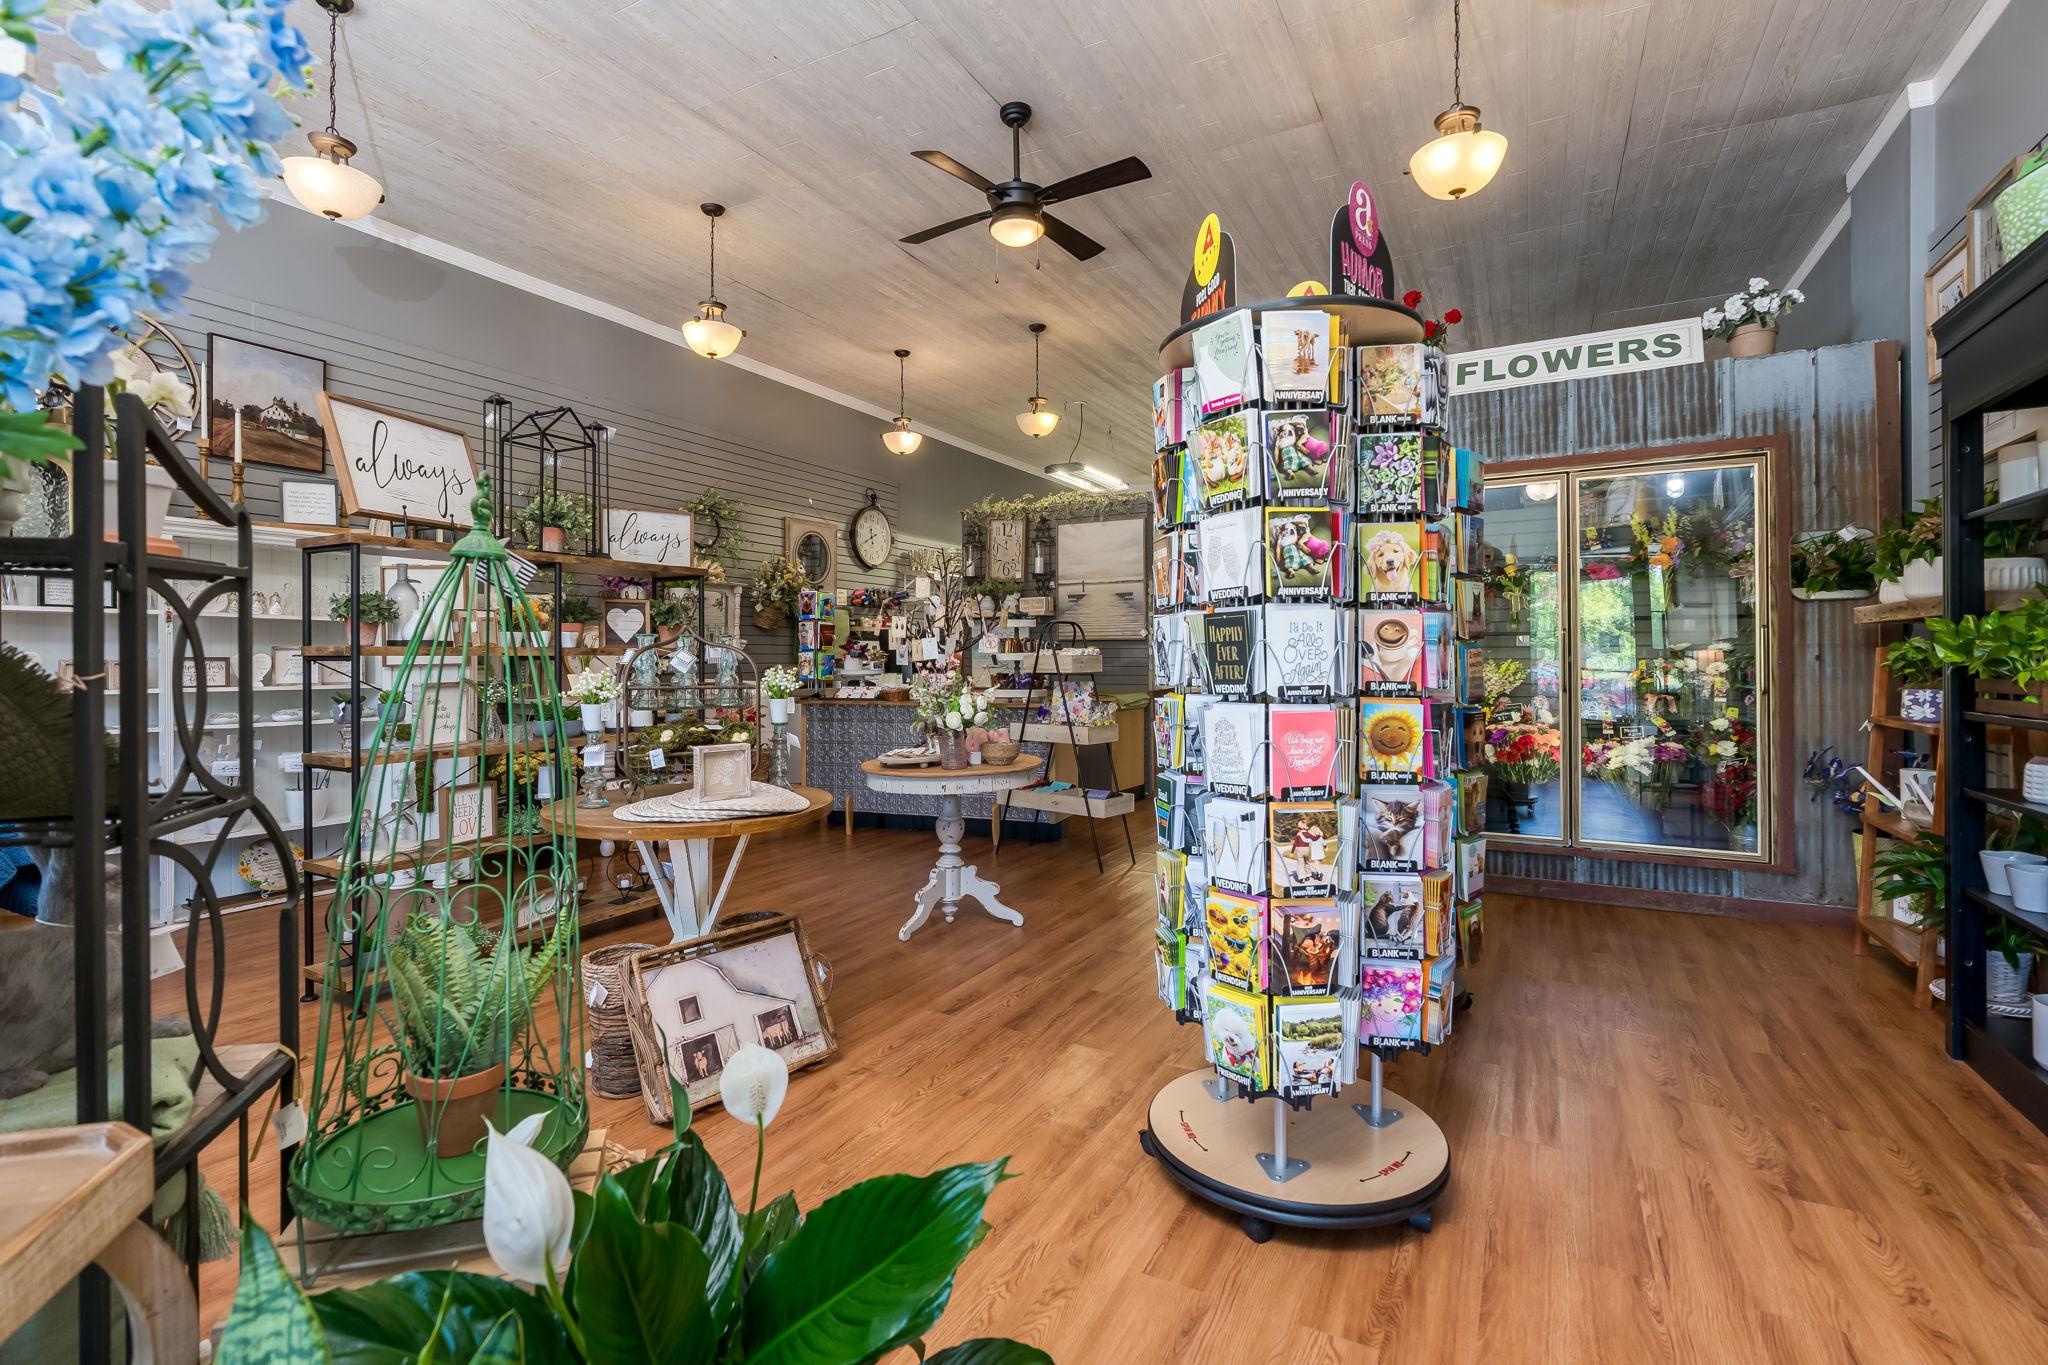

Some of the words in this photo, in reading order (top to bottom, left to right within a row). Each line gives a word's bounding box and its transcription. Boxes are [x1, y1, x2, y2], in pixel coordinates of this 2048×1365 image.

[1341, 240, 1385, 299] HUMOR
[1207, 272, 1220, 296] GOOD
[1456, 333, 1682, 386] FLOWERS
[1275, 390, 1325, 400] ANNIVERSARY
[1370, 414, 1397, 424] BLANK
[356, 420, 471, 518] always
[1210, 489, 1242, 505] WEDDING
[1278, 488, 1328, 498] ANNIVERSARY
[1370, 504, 1398, 512] BLANK
[1002, 522, 1013, 537] 12
[608, 512, 689, 562] always
[1002, 561, 1010, 576] 6
[1211, 588, 1243, 600] WEDDING
[1278, 586, 1328, 596] ANNIVERSARY
[1302, 622, 1314, 632] Do
[1316, 621, 1324, 632] It
[1208, 625, 1244, 642] HAPPILY
[1216, 644, 1239, 662] EVER
[1214, 663, 1244, 680] AFTER!
[1283, 661, 1328, 684] Again
[1215, 684, 1247, 694] WEDDING
[1370, 682, 1397, 690] BLANK
[1370, 772, 1398, 780] BLANK
[1215, 784, 1247, 795] WEDDING
[452, 806, 474, 818] NEED
[452, 816, 486, 838] LOVE
[1370, 860, 1398, 868] BLANK
[1215, 878, 1246, 892] WEDDING
[1372, 950, 1399, 958] BLANK
[1374, 1037, 1400, 1046] BLANK
[1218, 1067, 1250, 1086] FRIENDSHI
[1292, 1088, 1329, 1096] ANNIVERSARY
